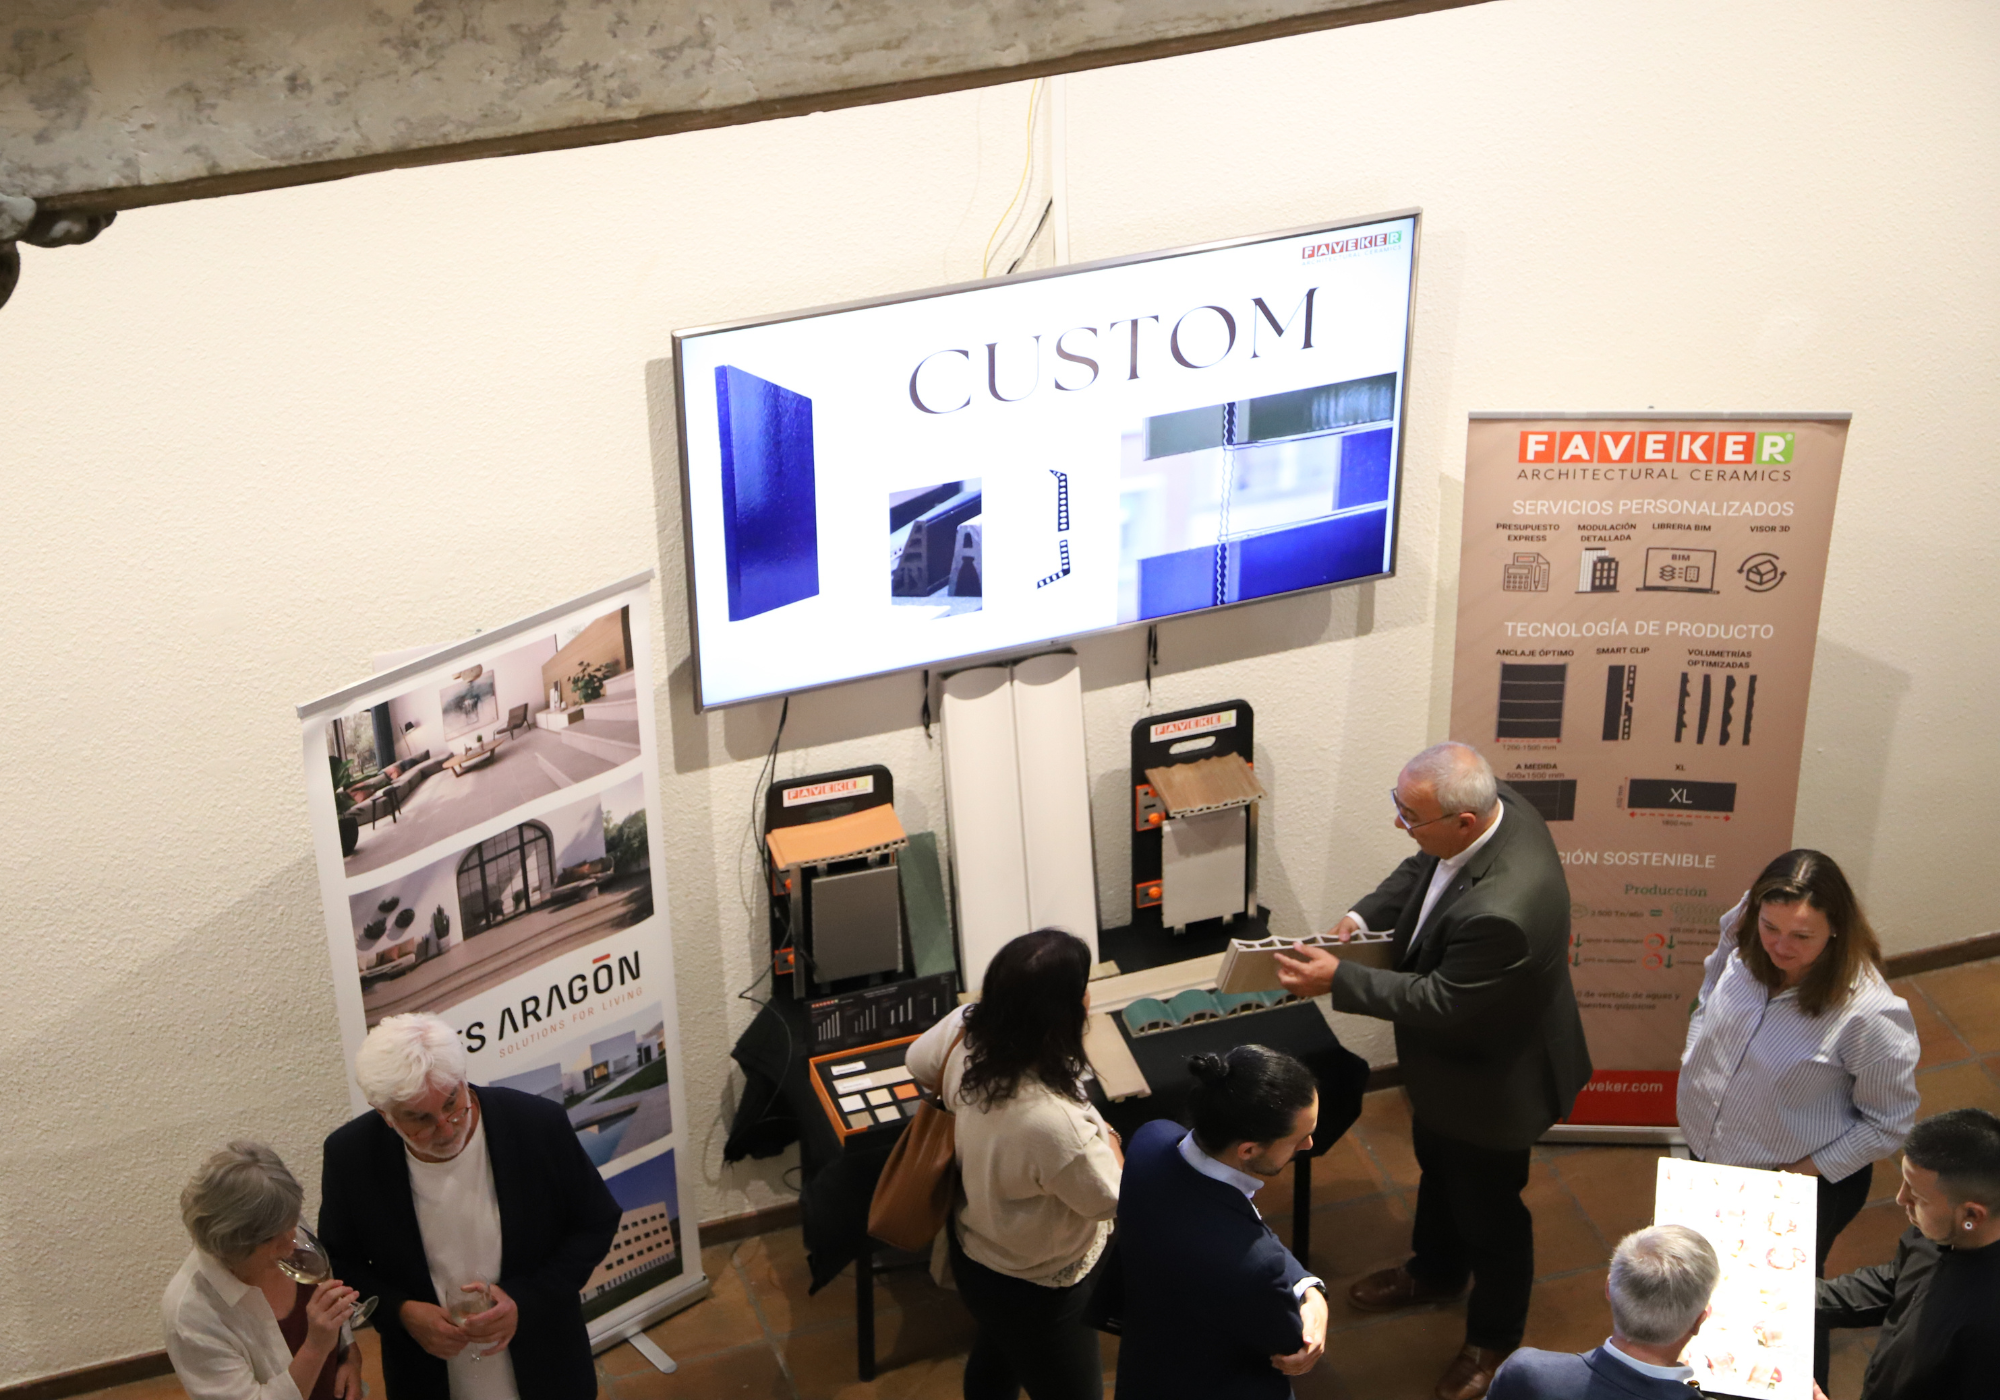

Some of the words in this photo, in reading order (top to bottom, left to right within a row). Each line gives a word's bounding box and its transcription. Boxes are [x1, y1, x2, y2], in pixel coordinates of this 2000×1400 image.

[1302, 230, 1402, 259] FAVEKER
[908, 287, 1318, 415] CUSTOM
[1517, 468, 1679, 481] ARCHITECTURAL
[1690, 469, 1792, 482] CERAMICS
[1512, 500, 1613, 515] SERVICIOS
[1619, 499, 1794, 517] PERSONALIZADOS
[1496, 523, 1560, 531] PRESUPUESTO
[1578, 522, 1637, 531] MODULACIÓN
[1694, 524, 1711, 532] BIM
[1507, 534, 1547, 542] EXPRESS
[1580, 534, 1632, 542] DETALLADA
[1504, 618, 1629, 637] TECNOLOGÍA
[1634, 621, 1660, 636] DE
[1665, 621, 1774, 640] PRODUCTO
[1496, 649, 1537, 657] ANCLAJE
[1538, 648, 1574, 657] ÓPTIMO
[1596, 647, 1627, 655] SMART
[1629, 646, 1650, 654] CLIP
[1687, 648, 1752, 659] VOLUMETRÍAS
[1687, 659, 1750, 669] OPTIMIZADAS
[1669, 787, 1693, 804] XL
[1558, 848, 1598, 866] CIÓN
[1603, 851, 1716, 869] SOSTENIBLE
[1624, 883, 1708, 898] Producción
[499, 1020, 566, 1059] SOLUTIONS
[572, 1007, 594, 1023] FOR
[602, 986, 643, 1011] LIVING
